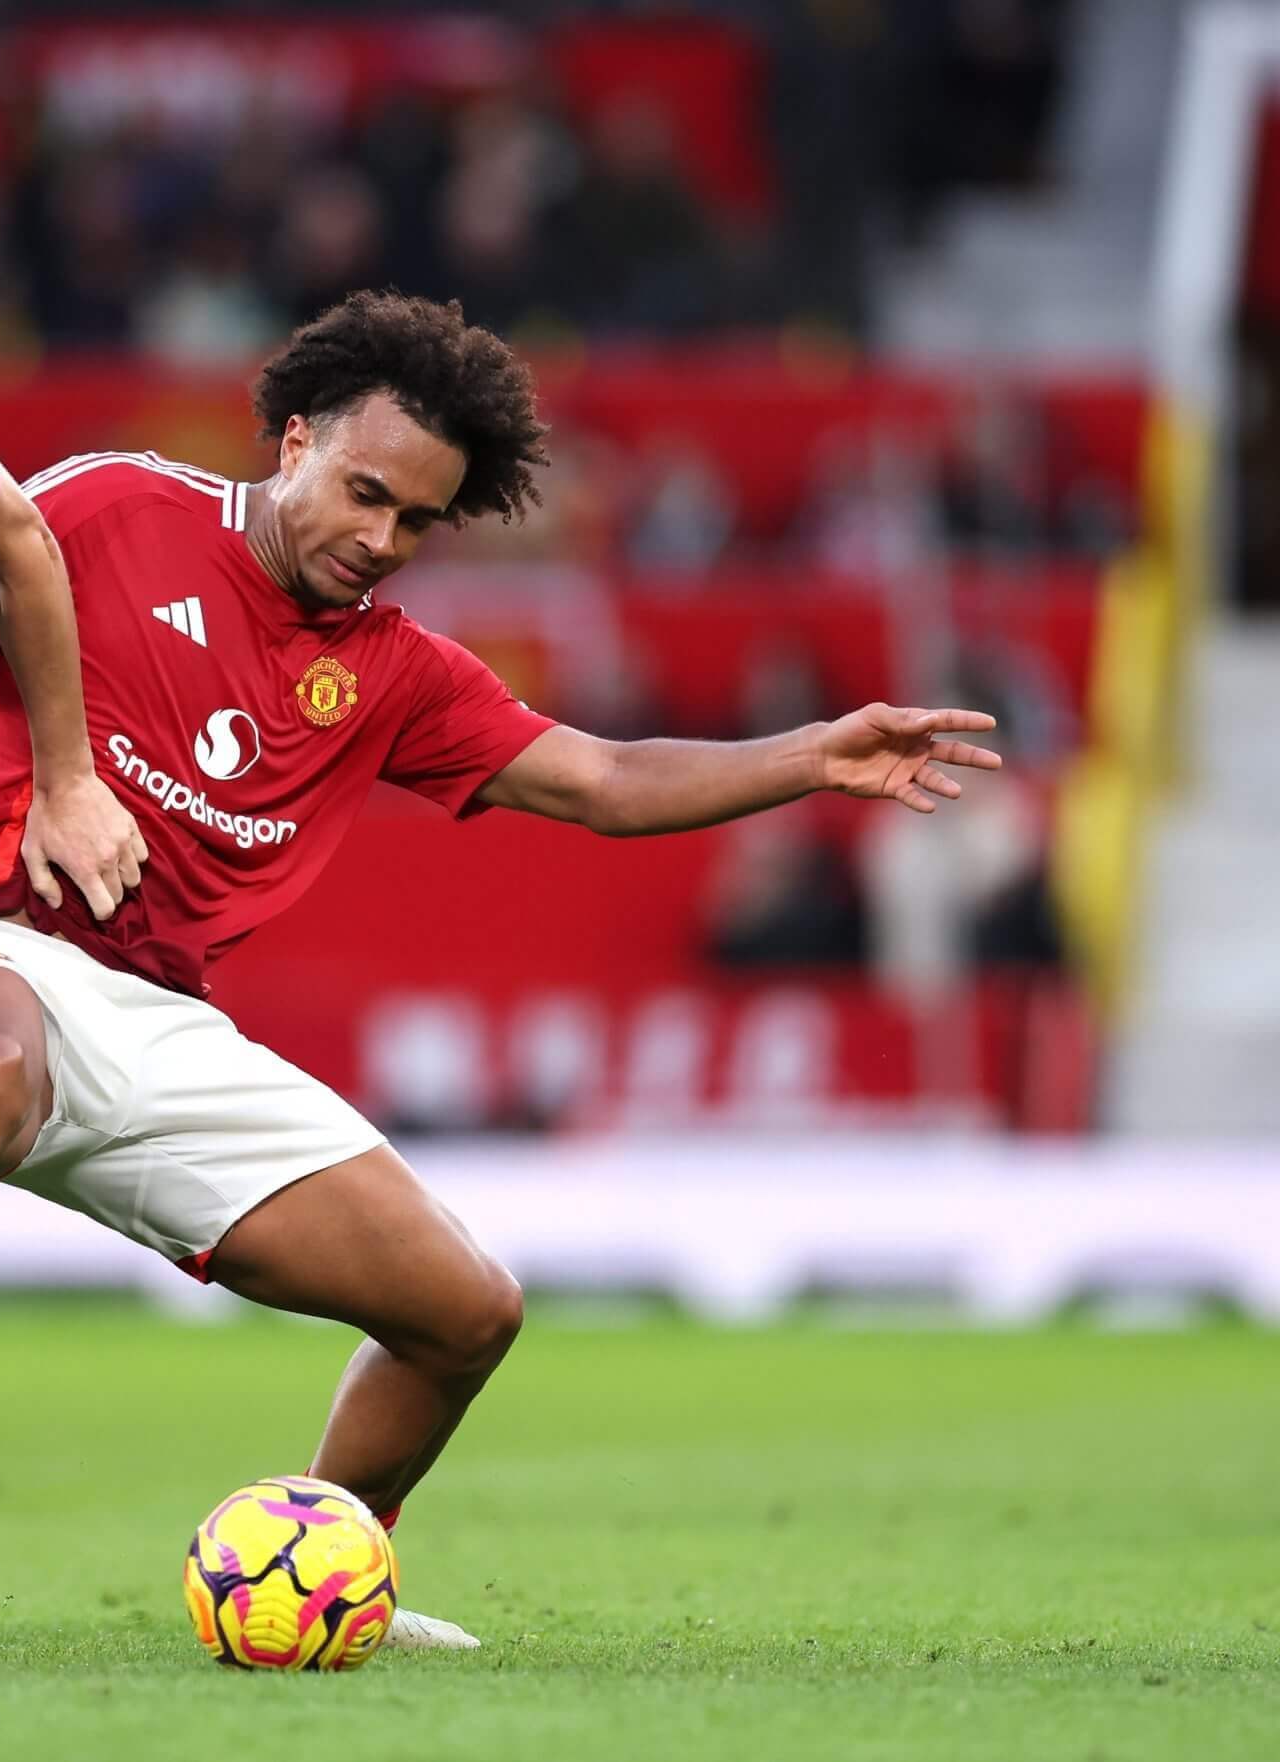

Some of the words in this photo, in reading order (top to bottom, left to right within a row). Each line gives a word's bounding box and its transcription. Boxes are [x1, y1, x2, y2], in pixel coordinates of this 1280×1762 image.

[303, 661, 353, 688] MANCHESTER
[305, 706, 341, 721] UNITED
[108, 734, 297, 848] Snapdragon
